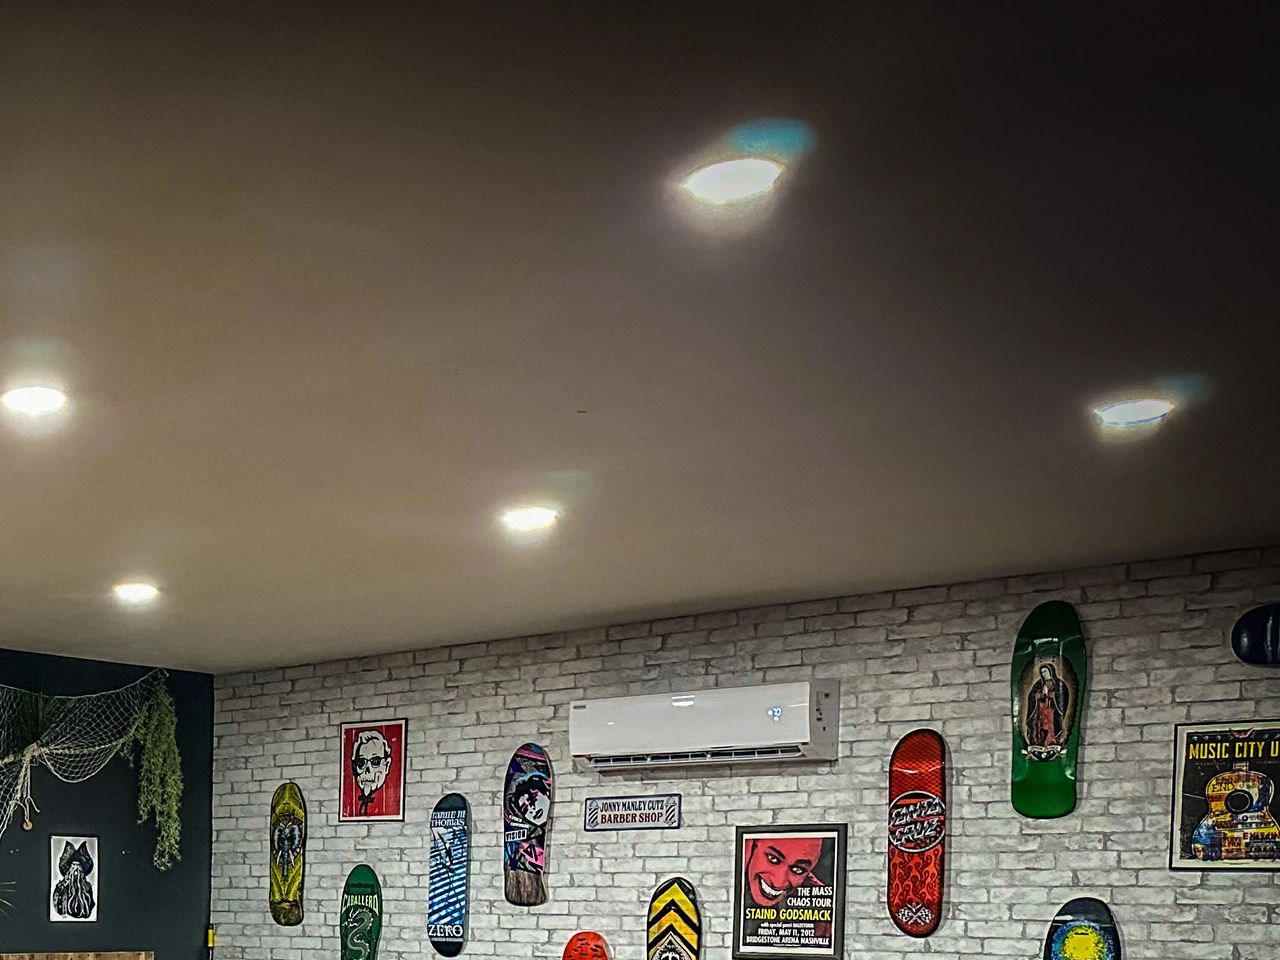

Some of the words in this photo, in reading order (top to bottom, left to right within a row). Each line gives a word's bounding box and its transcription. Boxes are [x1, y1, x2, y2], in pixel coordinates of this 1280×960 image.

[1189, 742, 1229, 759] MUSIC
[1235, 741, 1265, 758] CITY
[600, 801, 621, 813] JONNY
[621, 800, 648, 811] MANLEY
[647, 799, 664, 811] CUTZ
[888, 797, 942, 827] SANTA
[600, 813, 637, 824] BARBER
[638, 811, 663, 823] SHOP
[893, 818, 939, 846] CRUZ
[797, 887, 810, 896] THE
[812, 886, 833, 896] MASS
[341, 893, 380, 917] CABALLERO
[787, 897, 811, 907] CHAOS
[812, 898, 832, 907] TOUR
[745, 908, 777, 920] STAIND
[780, 908, 831, 921] GODSMACK
[428, 924, 463, 937] ZERO
[758, 928, 778, 936] FRIDAY,
[779, 928, 792, 936] MAY
[792, 929, 800, 937] 11,
[800, 929, 815, 937] 2012
[746, 935, 781, 944] BRIDGESTONE
[781, 936, 800, 944] ARENA
[800, 937, 830, 945] NASHVILLE
